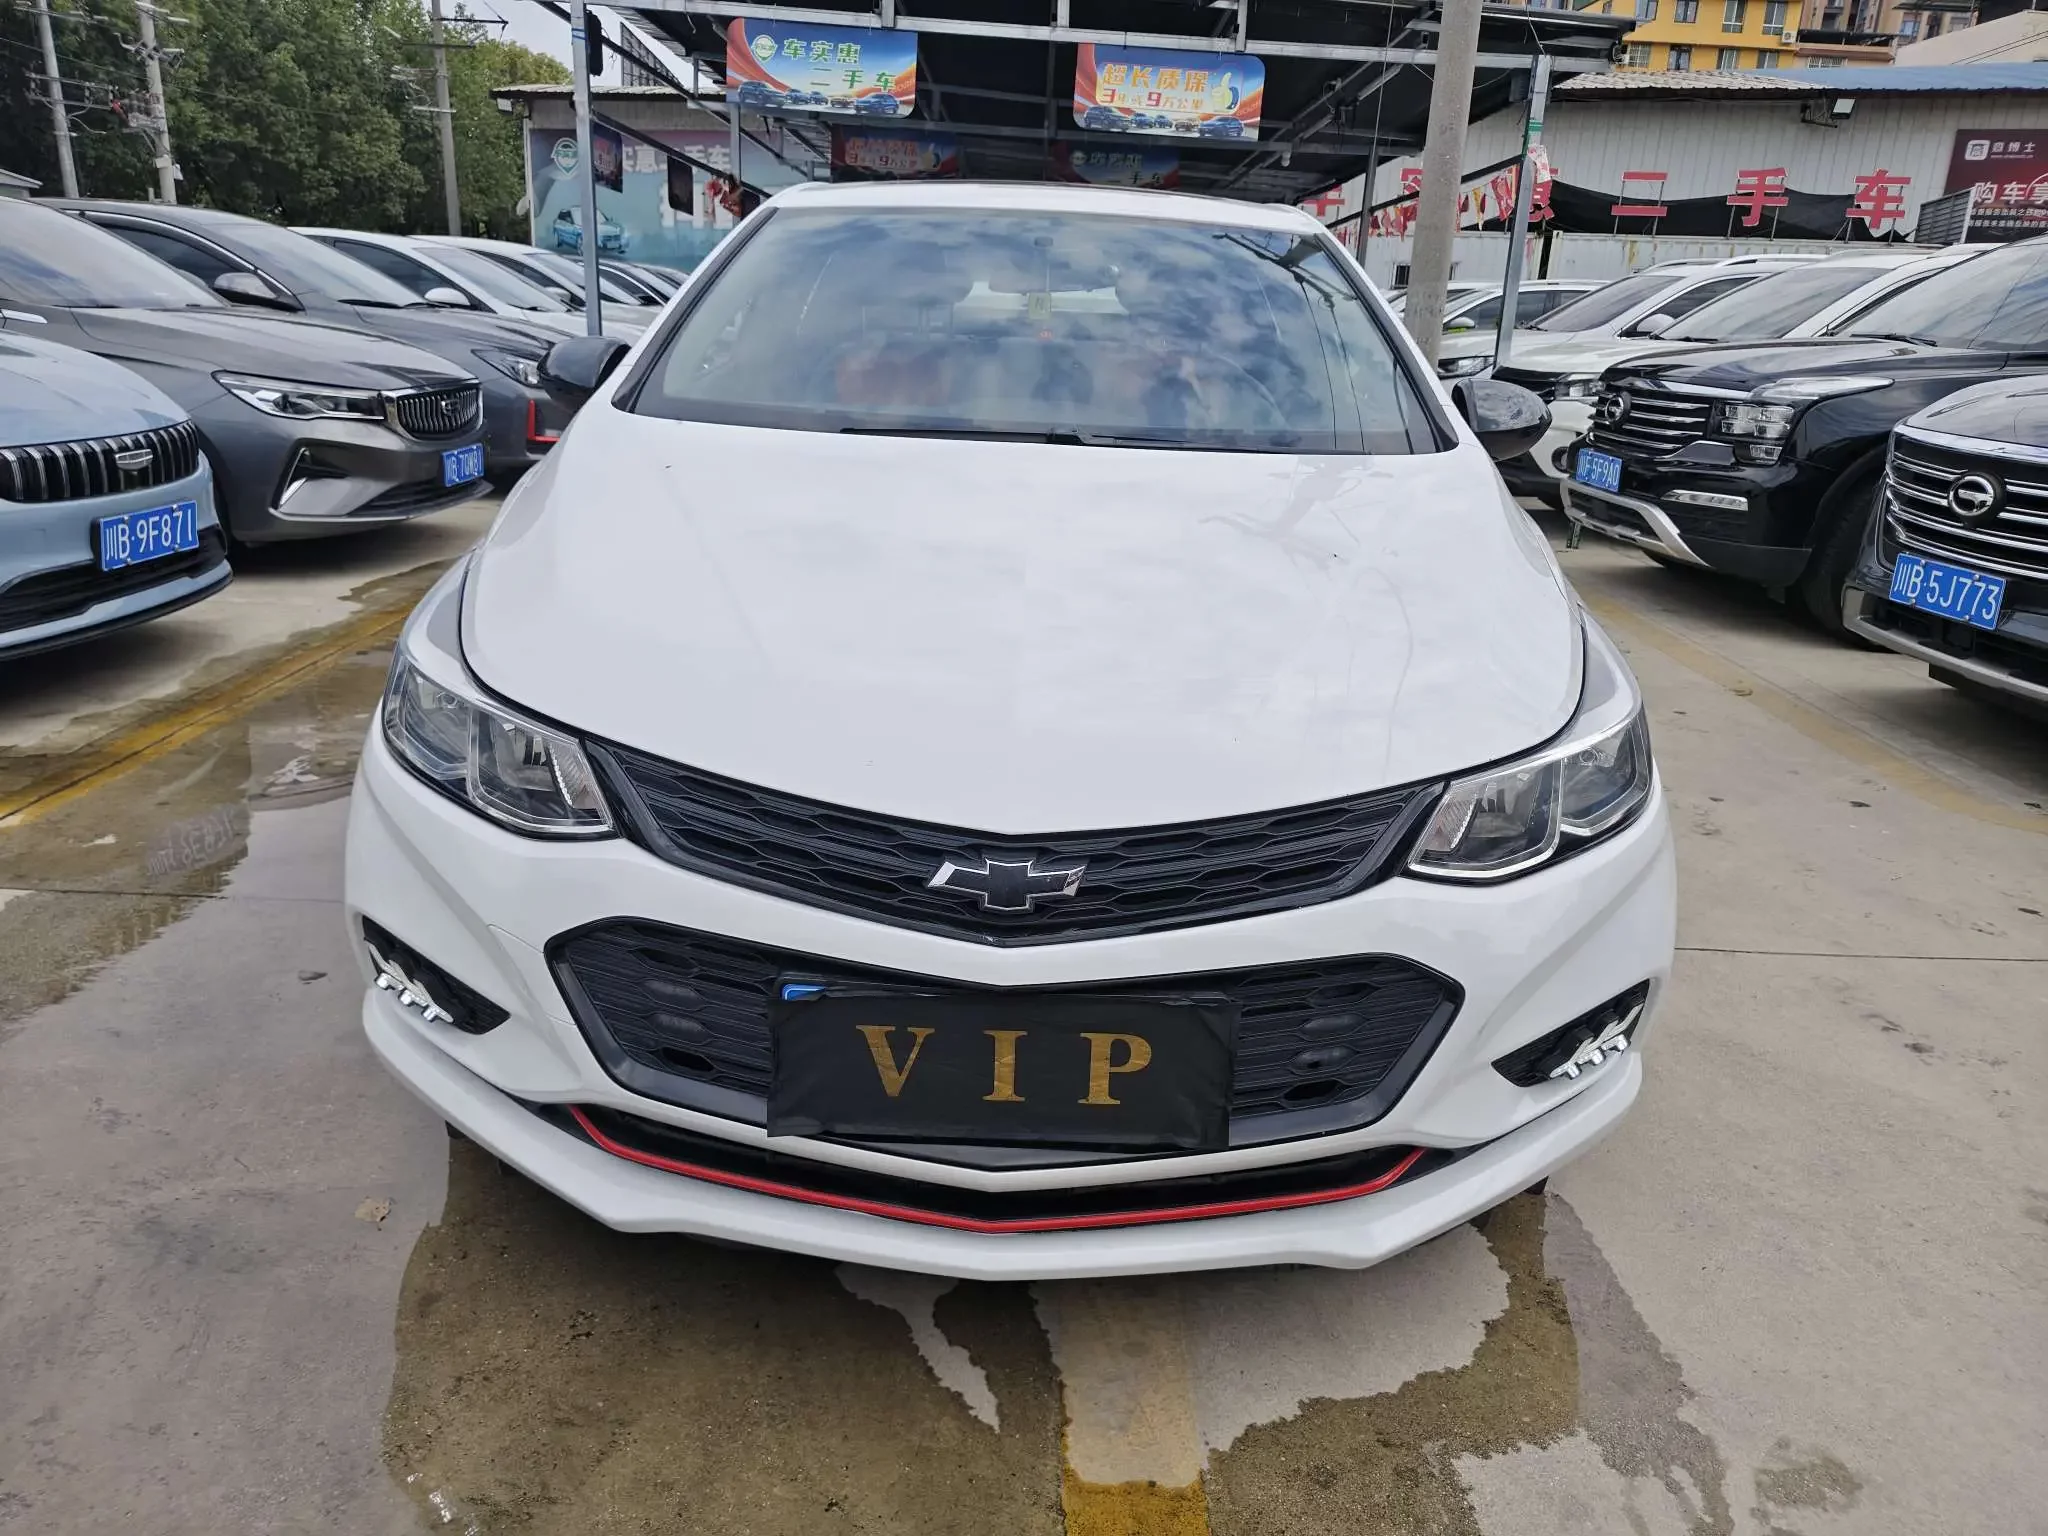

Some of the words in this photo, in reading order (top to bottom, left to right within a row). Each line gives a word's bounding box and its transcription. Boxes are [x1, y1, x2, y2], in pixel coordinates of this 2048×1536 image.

[782, 38, 862, 65] 车实惠
[810, 67, 897, 93] 二手车
[1103, 63, 1209, 93] 超长质保
[856, 1024, 1153, 1106] VIP
